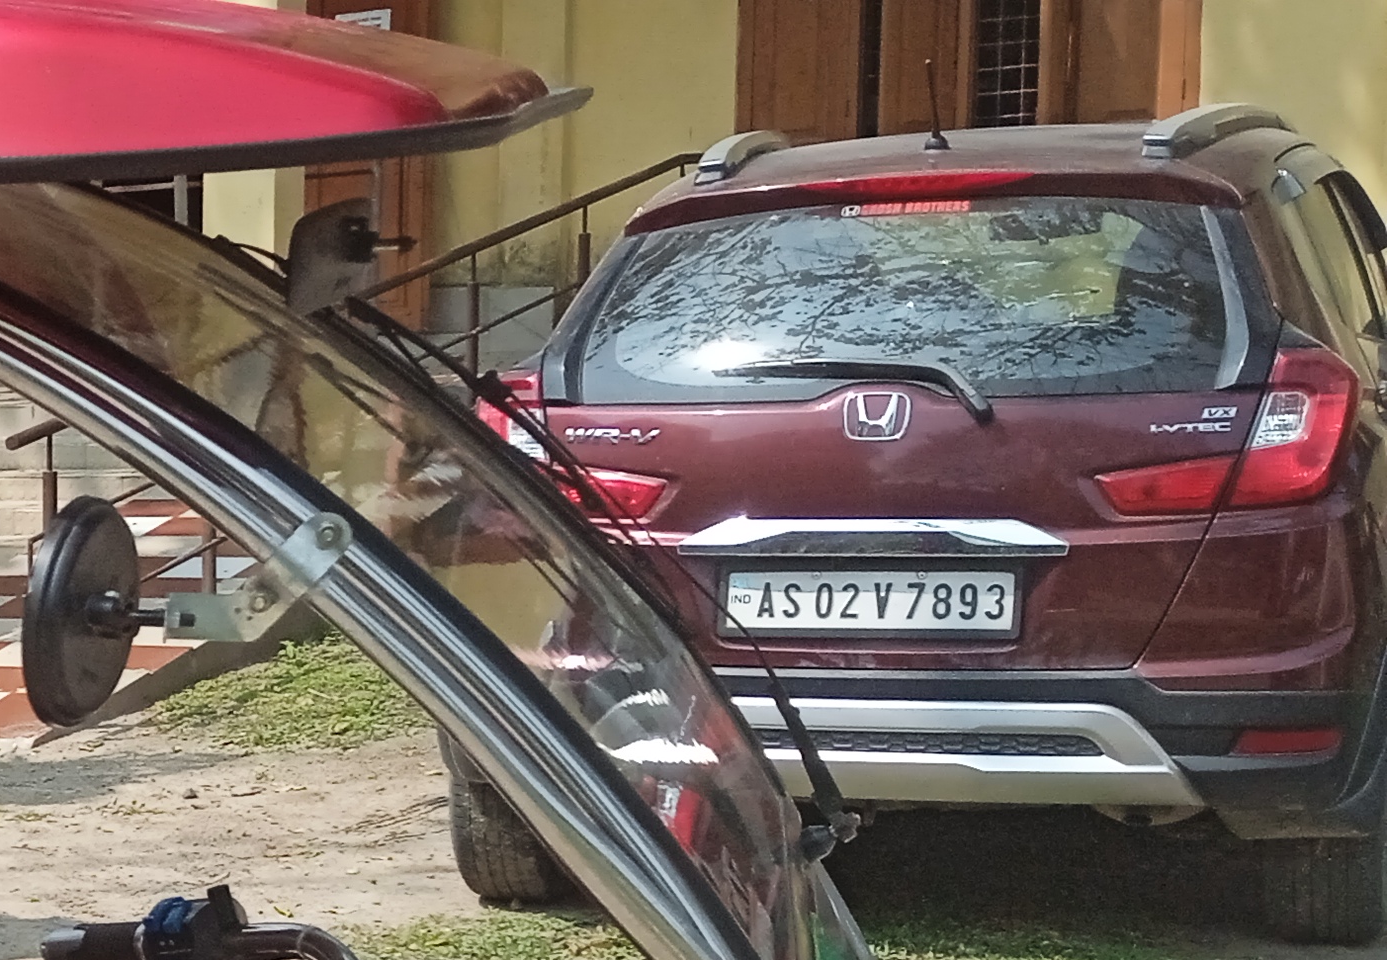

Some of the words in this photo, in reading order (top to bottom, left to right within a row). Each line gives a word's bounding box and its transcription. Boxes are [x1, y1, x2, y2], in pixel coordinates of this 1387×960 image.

[1208, 408, 1232, 416] VX
[564, 427, 661, 444] WR-V
[730, 594, 752, 604] IND
[756, 582, 802, 618] AS
[814, 582, 860, 619] 02
[873, 582, 893, 619] V
[905, 582, 1006, 620] 7893
